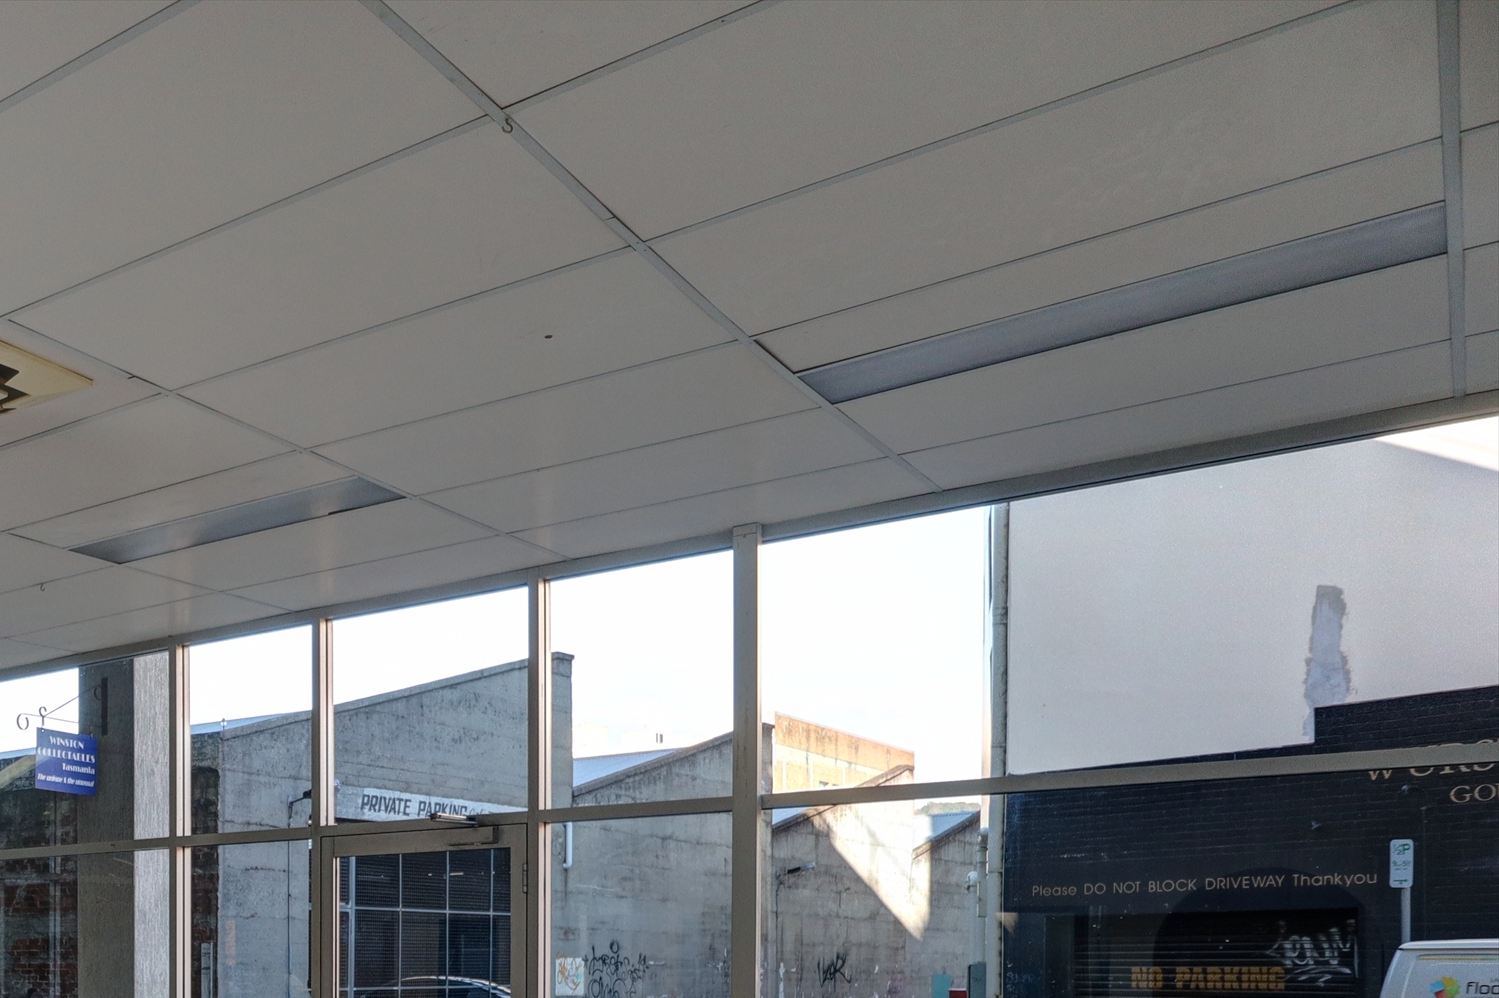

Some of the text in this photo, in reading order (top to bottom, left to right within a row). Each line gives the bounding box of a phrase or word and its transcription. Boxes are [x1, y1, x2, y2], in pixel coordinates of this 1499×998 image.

[49, 736, 85, 749] WINSTON
[37, 746, 96, 763] COLLECTABLES
[62, 762, 95, 775] Tasmania
[1449, 784, 1499, 803] GO
[360, 793, 412, 817] PRIVATE
[1032, 885, 1077, 897] Please
[1084, 883, 1107, 895] DO
[1113, 881, 1141, 894] NOT
[1148, 878, 1197, 893] BLOCK
[1205, 874, 1285, 890] DRIVEWAY
[1131, 966, 1286, 991] NO PARKING
